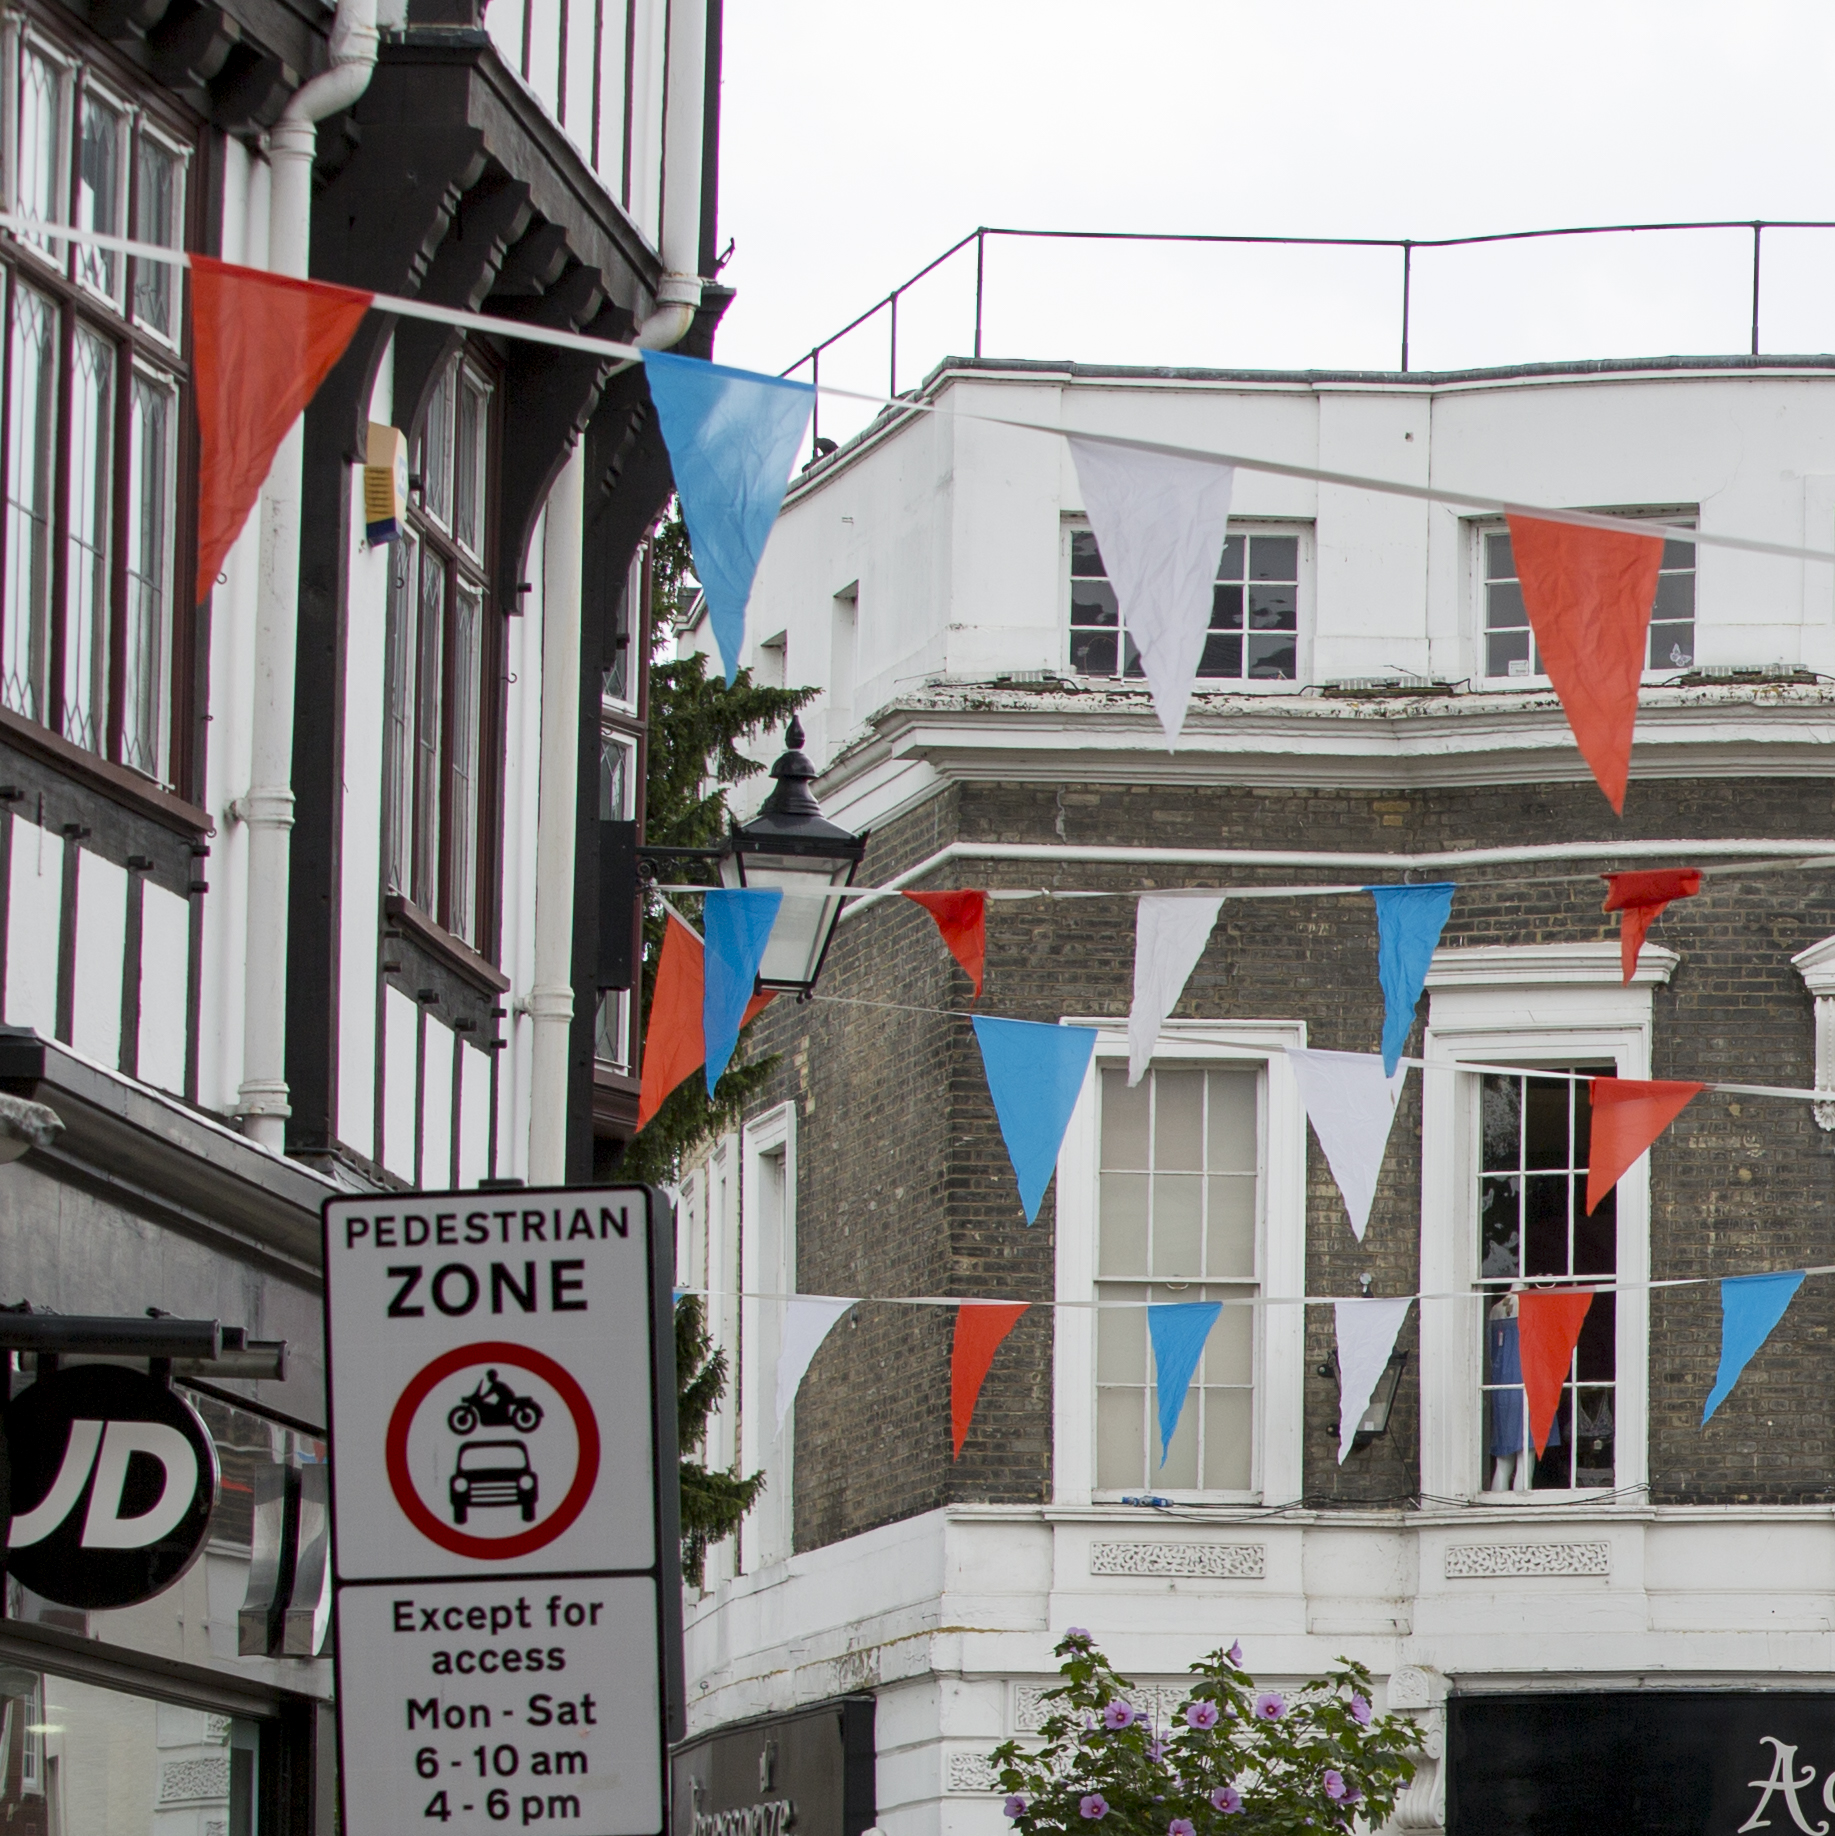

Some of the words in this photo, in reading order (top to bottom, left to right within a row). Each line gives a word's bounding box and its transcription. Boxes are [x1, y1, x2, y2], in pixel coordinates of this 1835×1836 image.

[346, 1206, 629, 1250] PEDESTRIAN
[386, 1259, 588, 1318] ZONE
[6, 1419, 197, 1549] JD
[392, 1596, 532, 1635] Except
[546, 1595, 604, 1627] for
[431, 1647, 566, 1675] access
[406, 1697, 492, 1730] Mon
[526, 1693, 598, 1727] Sat
[415, 1747, 440, 1779] 6
[473, 1744, 520, 1778] 10
[530, 1749, 589, 1776] am
[424, 1790, 451, 1823] 4
[486, 1788, 510, 1821] 6
[521, 1793, 581, 1826] pm
